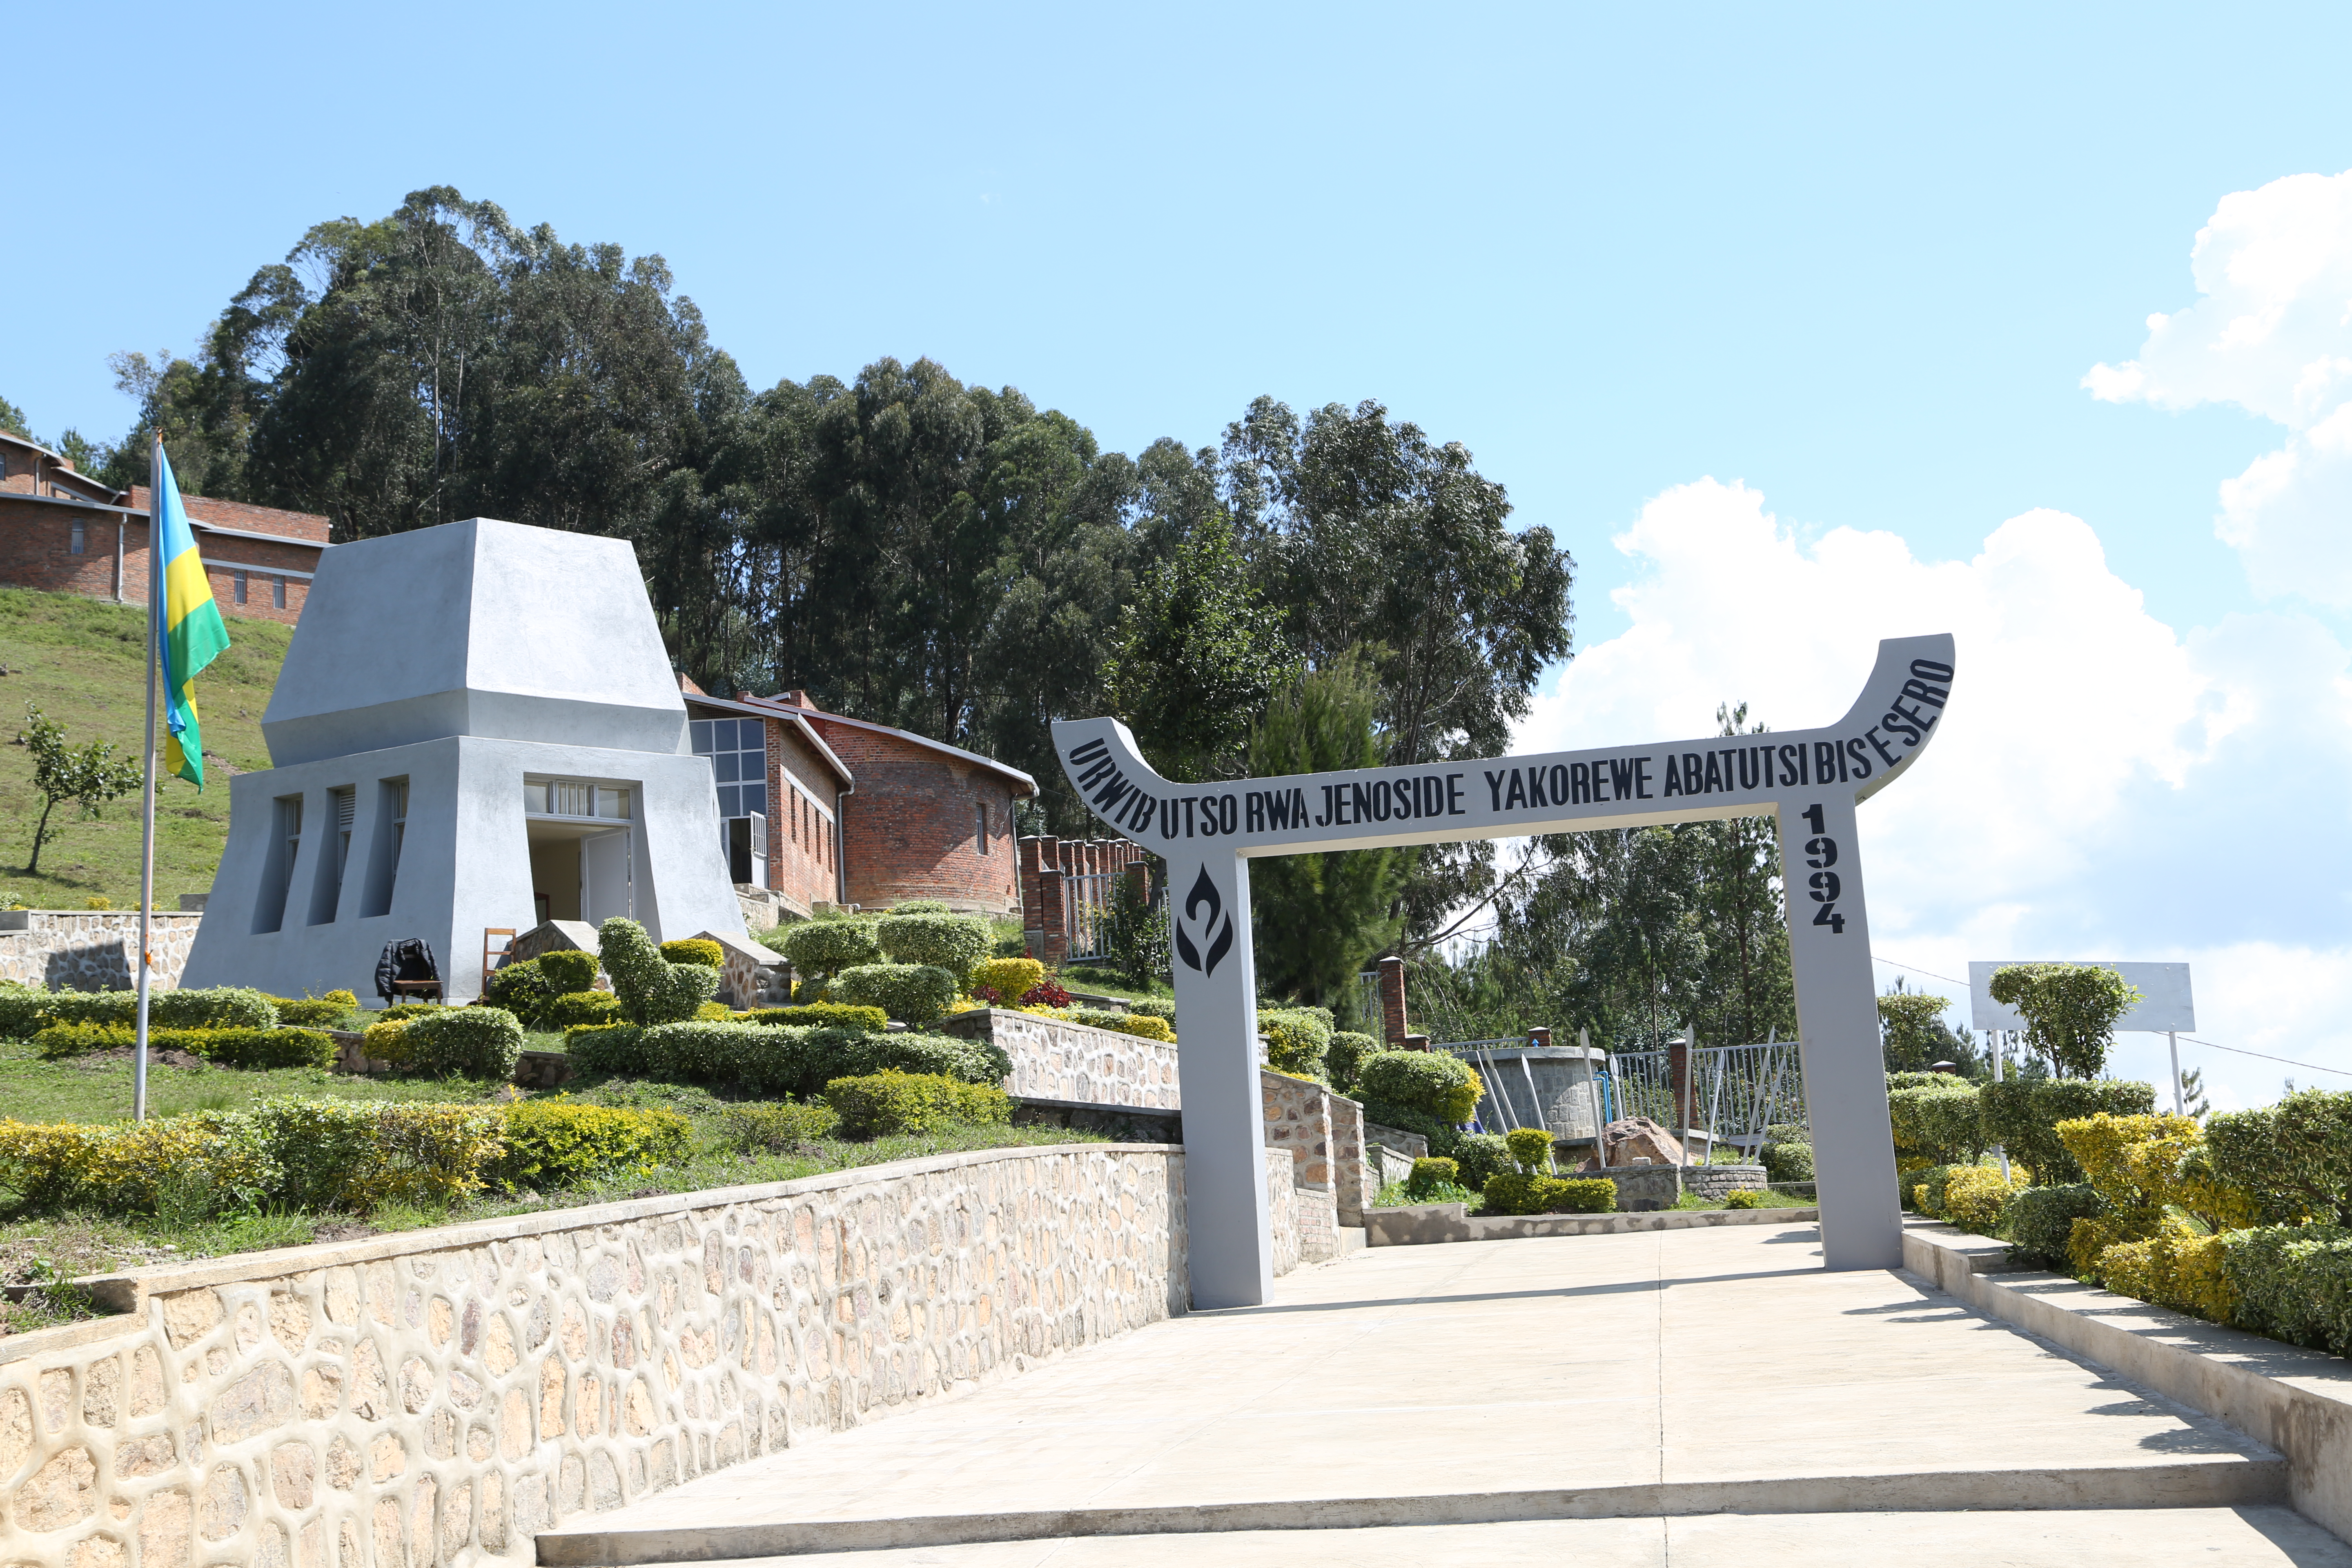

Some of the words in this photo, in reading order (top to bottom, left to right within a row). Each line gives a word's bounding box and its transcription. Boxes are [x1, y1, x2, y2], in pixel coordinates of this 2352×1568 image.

[1069, 737, 1238, 840] URWIBUTSO
[1245, 788, 1310, 833] RWA
[1316, 773, 1466, 827] JENOSIDE
[1483, 757, 1653, 811] YAKOREWE
[1664, 743, 1809, 797] ABATUTSI
[1814, 659, 1954, 784] BISESERO
[1802, 803, 1845, 934] 1994
